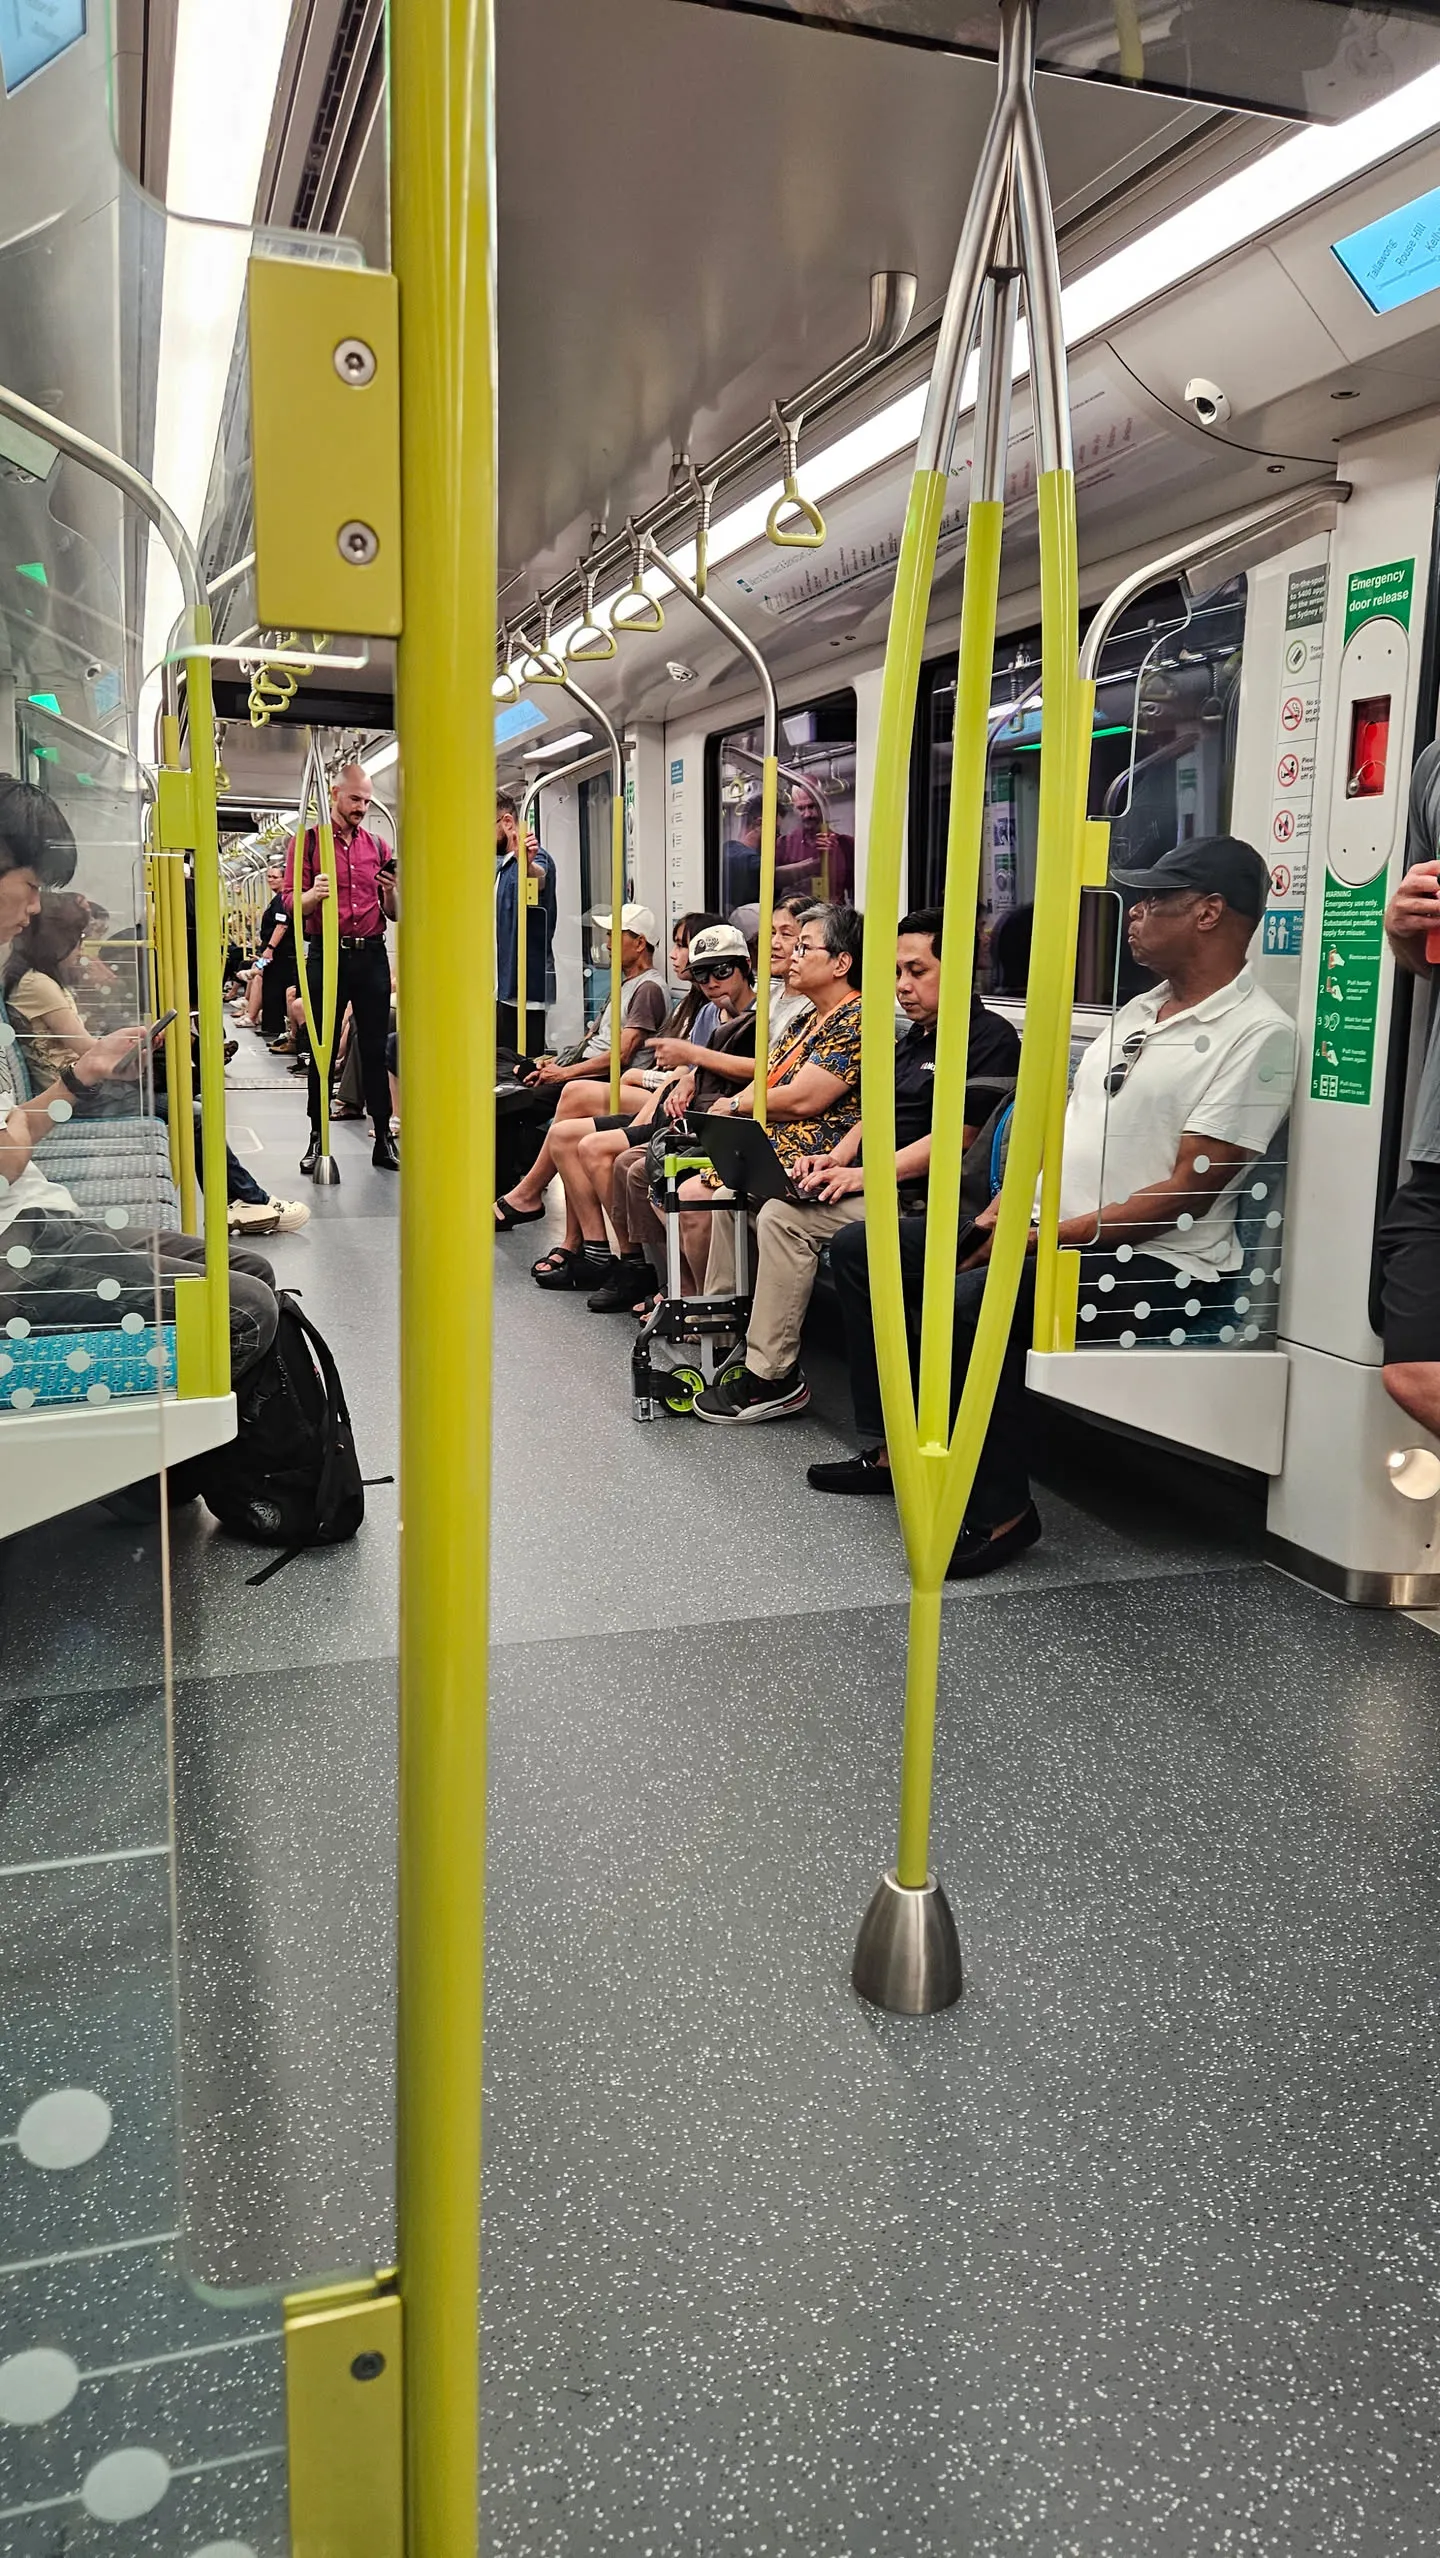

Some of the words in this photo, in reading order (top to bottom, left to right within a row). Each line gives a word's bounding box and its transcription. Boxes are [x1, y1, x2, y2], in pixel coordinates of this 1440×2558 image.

[1395, 240, 1417, 267] Rouse
[1411, 222, 1426, 241] Hill
[1366, 239, 1398, 280] Tallawong
[1350, 570, 1405, 592] Emergency
[1290, 591, 1298, 600] to
[1289, 602, 1297, 611] do
[1298, 599, 1308, 609] the
[1349, 598, 1371, 612] door
[1373, 590, 1409, 607] release
[1297, 608, 1318, 620] Sydney
[1326, 890, 1352, 898] WARNING
[1325, 900, 1353, 909] Emergency
[1364, 899, 1378, 908] only.
[1359, 909, 1384, 917] required.
[1323, 919, 1353, 927] Substantial
[1352, 919, 1378, 928] penalties
[1323, 929, 1337, 938] apply
[1319, 984, 1325, 994] 2
[1316, 1016, 1322, 1026] 3
[1315, 1048, 1321, 1057] 4
[1313, 1079, 1318, 1089] 5
